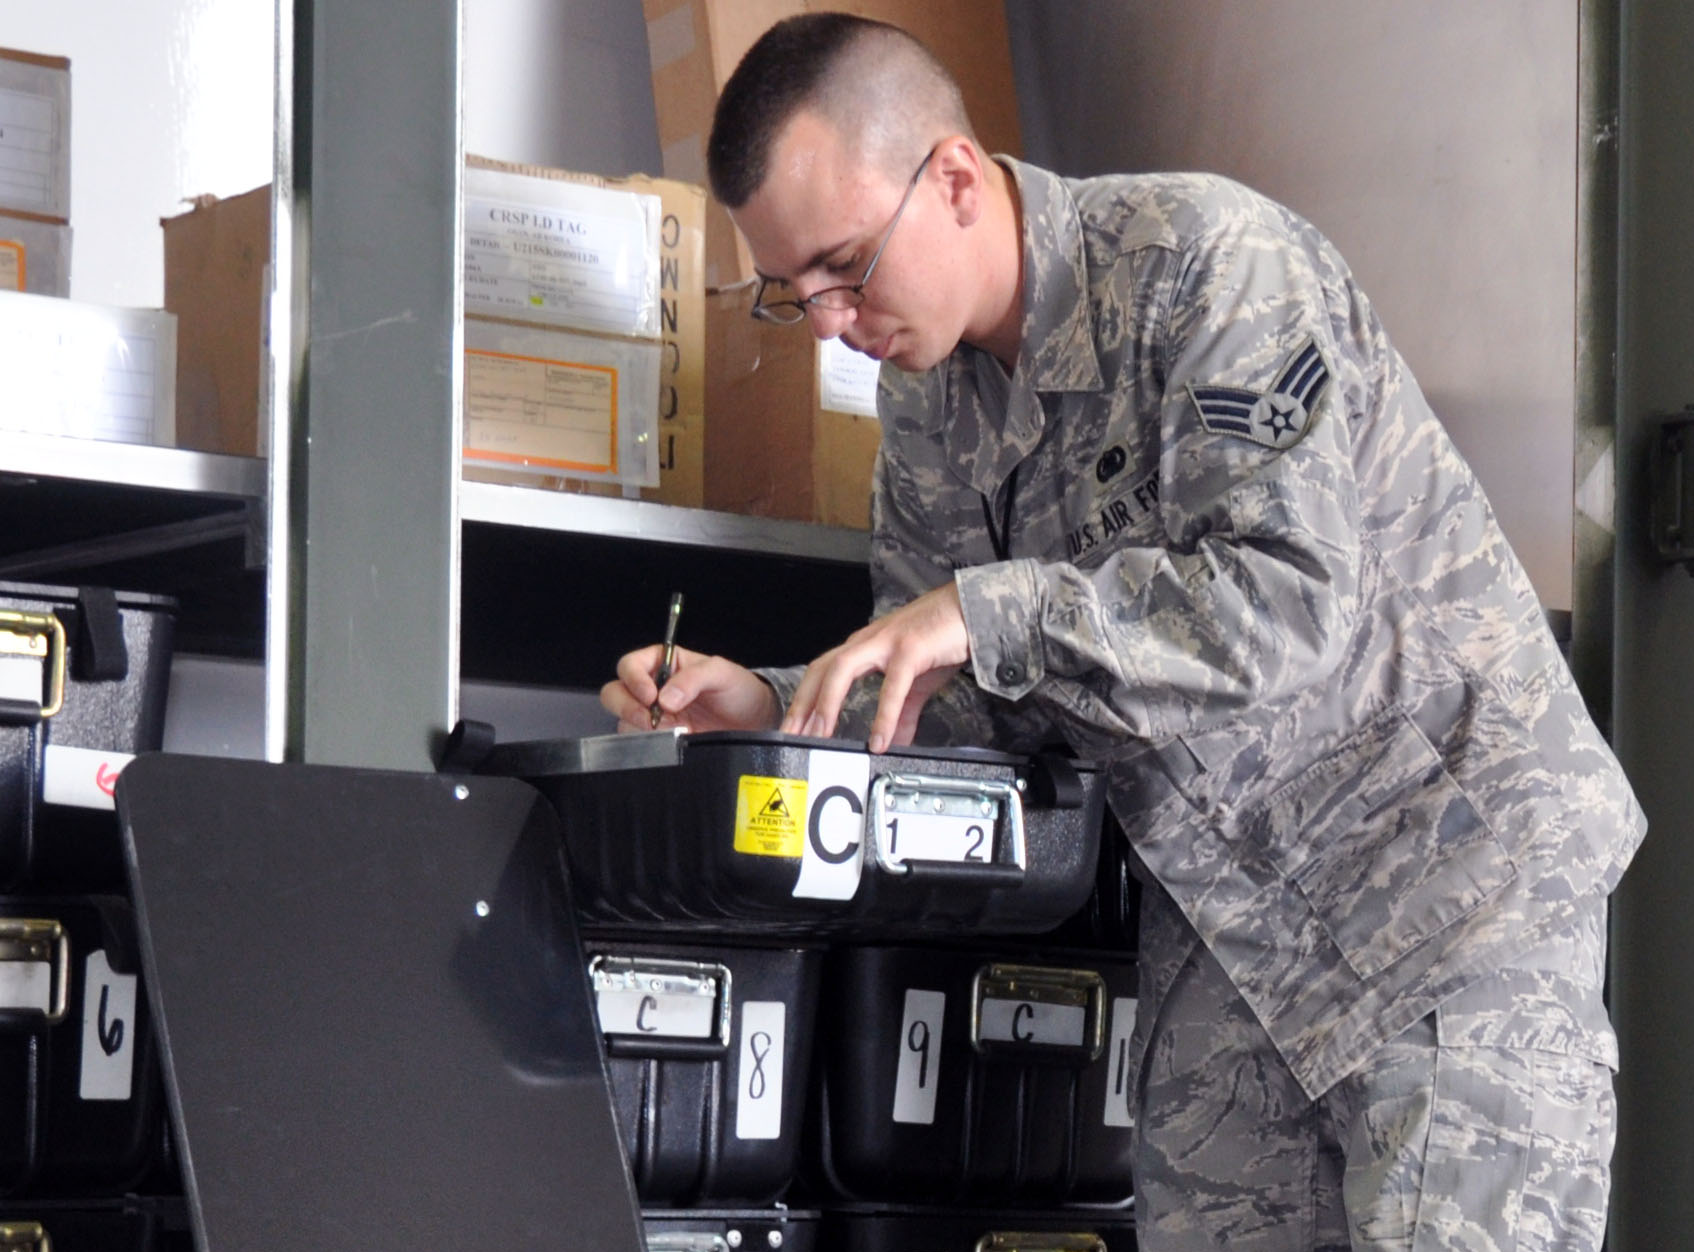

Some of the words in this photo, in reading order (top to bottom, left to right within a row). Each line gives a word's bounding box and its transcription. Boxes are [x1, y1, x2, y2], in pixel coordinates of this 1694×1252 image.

[489, 207, 530, 226] CRSP
[557, 218, 588, 235] TAG
[1101, 500, 1134, 538] AIR
[808, 785, 863, 865] C
[886, 817, 899, 854] 1
[963, 824, 985, 861] 2
[97, 984, 123, 1057] 6
[636, 995, 658, 1032] C
[1011, 1002, 1035, 1043] C
[748, 1031, 772, 1100] 8
[908, 1019, 929, 1089] 9
